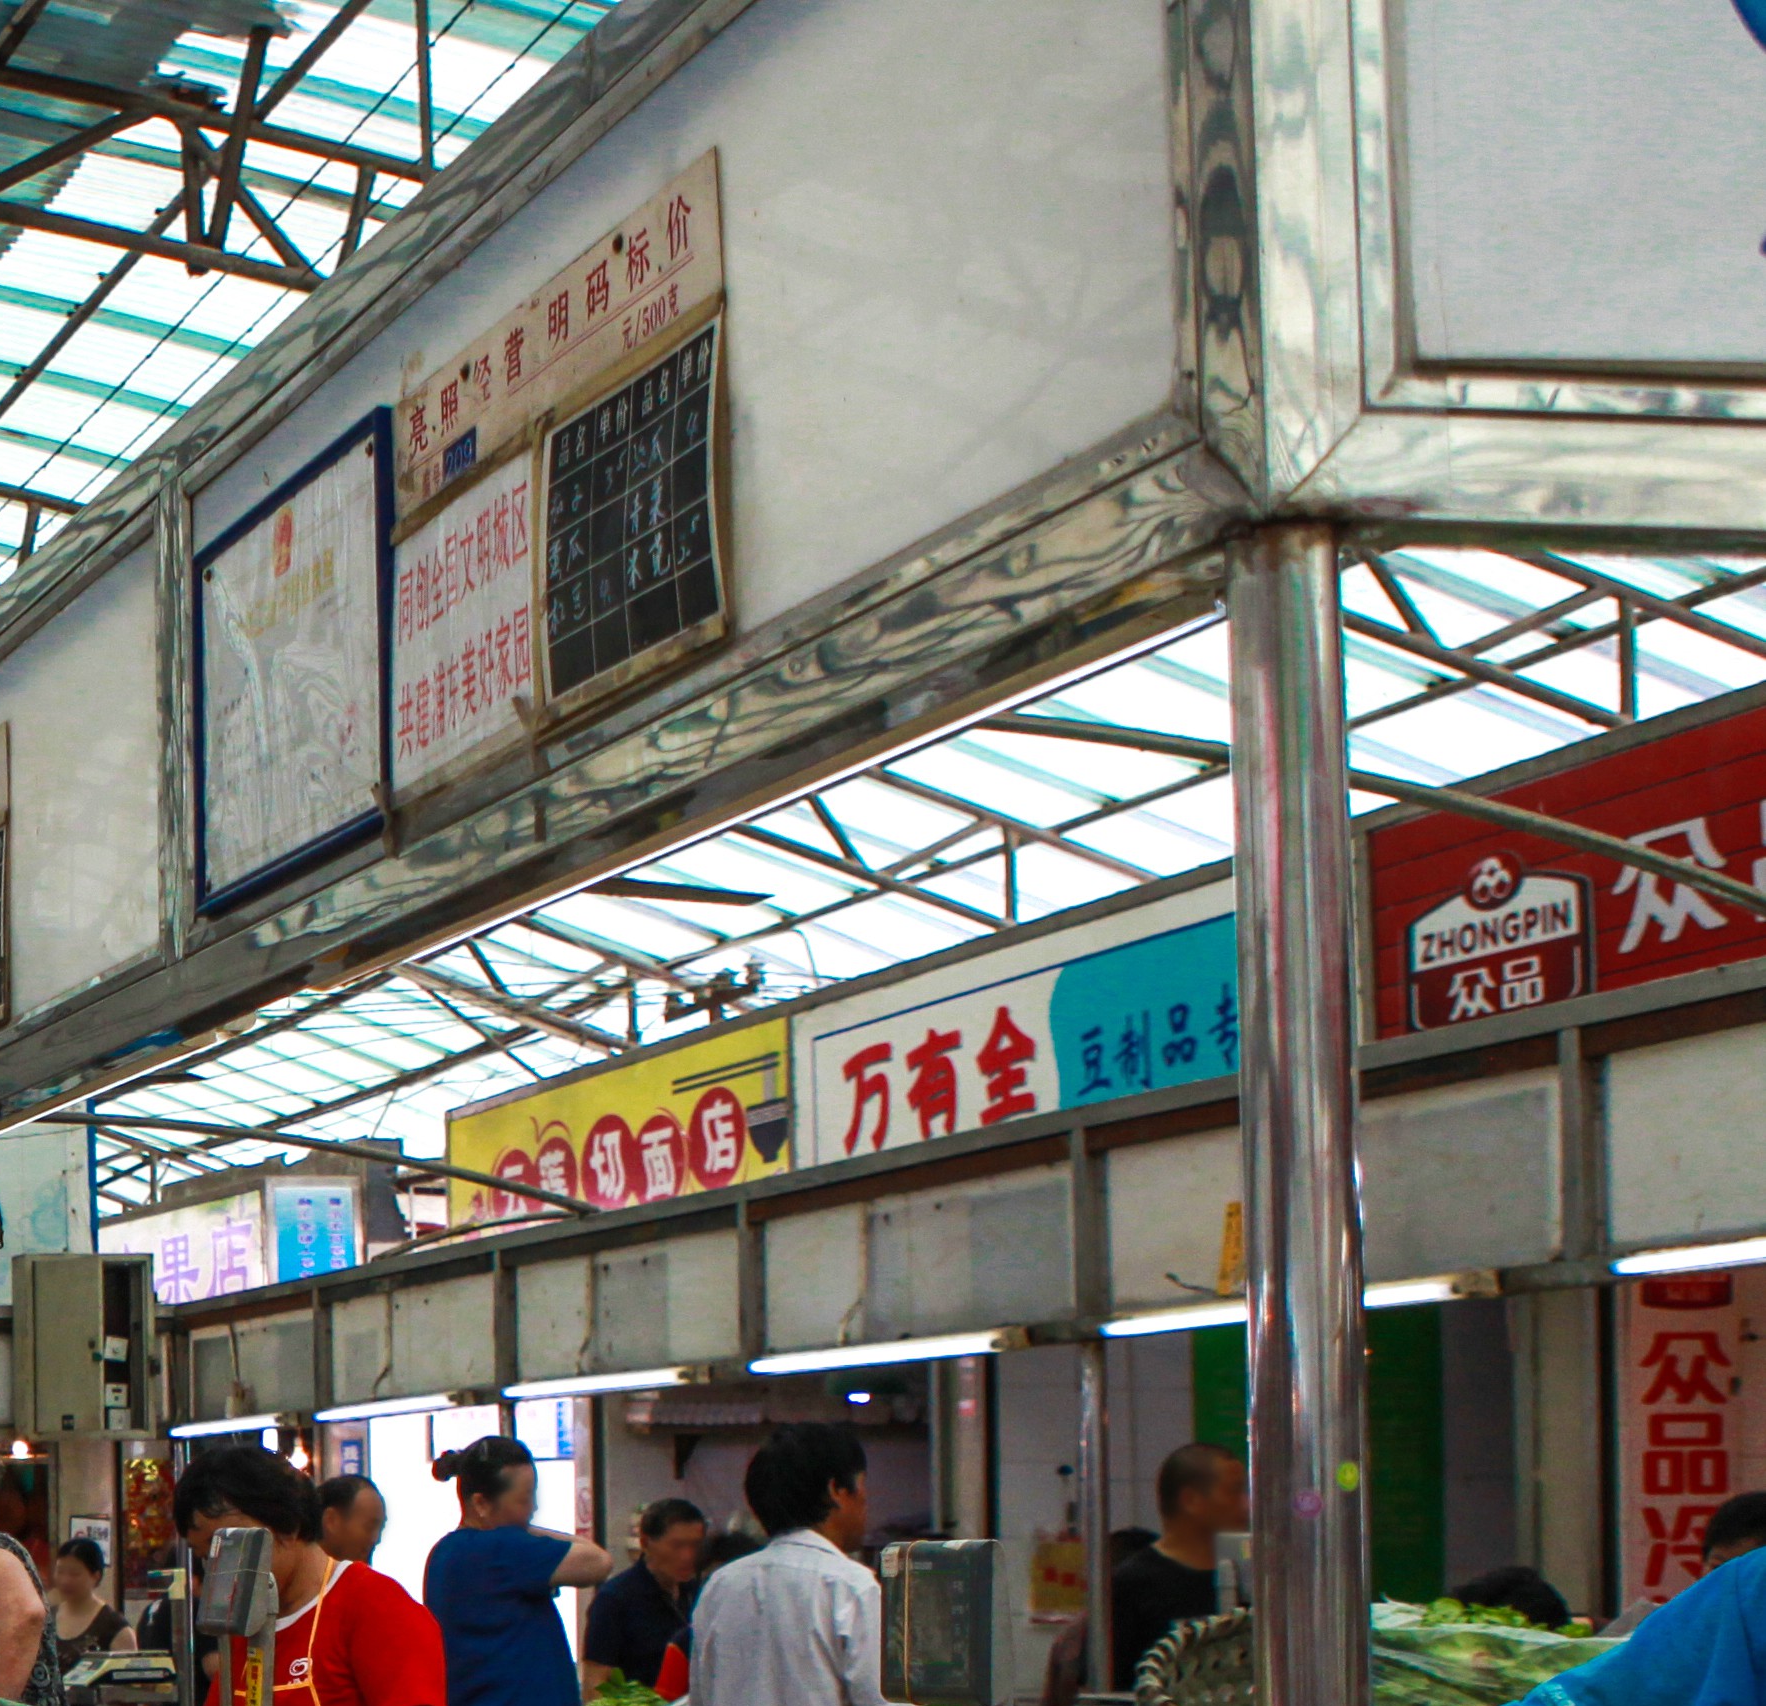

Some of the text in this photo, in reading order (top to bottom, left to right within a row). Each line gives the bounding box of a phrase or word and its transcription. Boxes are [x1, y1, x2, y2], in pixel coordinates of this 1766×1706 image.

[408, 195, 691, 456] 亮照经营明码标价
[397, 603, 531, 761] 共建浦东美好家园
[1420, 898, 1572, 964] ZHONGPIN
[1447, 955, 1545, 1021] 众品
[842, 1006, 1036, 1155] 万有全
